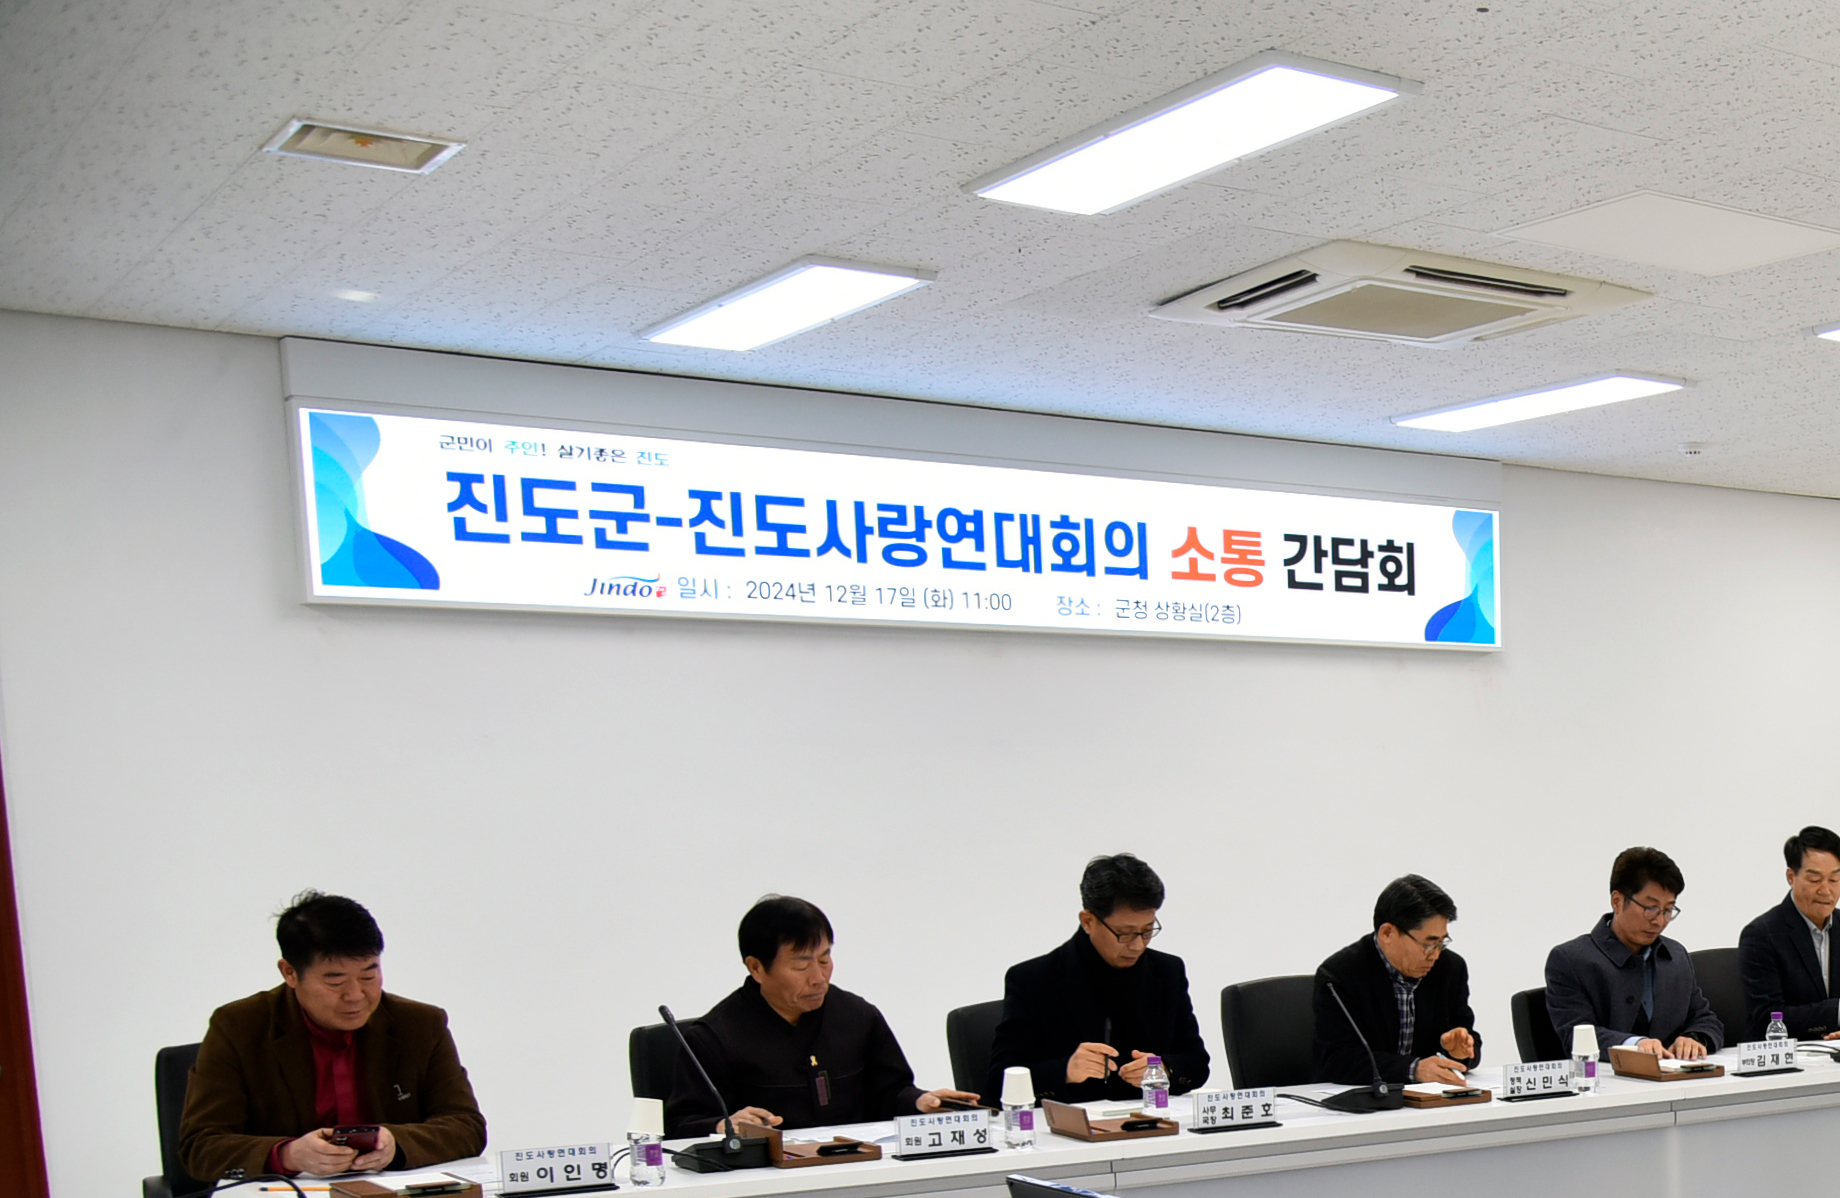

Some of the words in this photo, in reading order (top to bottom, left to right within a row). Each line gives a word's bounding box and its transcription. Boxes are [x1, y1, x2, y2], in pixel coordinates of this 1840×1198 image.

[438, 434, 493, 453] 군민이
[503, 439, 547, 457] 주인!
[556, 444, 627, 464] 살기좋은
[636, 451, 670, 467] 진도
[446, 471, 1148, 580] 진도군-진도사랑연대회의
[1170, 526, 1266, 588] 소통
[1282, 533, 1416, 596] 간담회
[746, 580, 817, 604] 2024년
[826, 584, 867, 607] 12월
[876, 586, 917, 608] 17일
[922, 588, 955, 611] (화)
[961, 591, 1013, 612] 11:00
[1115, 598, 1150, 620] 군청
[1155, 601, 1242, 625] 상황실(2층)
[1757, 1052, 1794, 1068] 김재현
[1525, 1074, 1569, 1091] 신민식
[1221, 1102, 1273, 1121] 최준호
[905, 1136, 922, 1147] 회원
[928, 1128, 988, 1148] 고재성
[509, 1171, 530, 1183] 회원
[536, 1161, 609, 1184] 이인명
